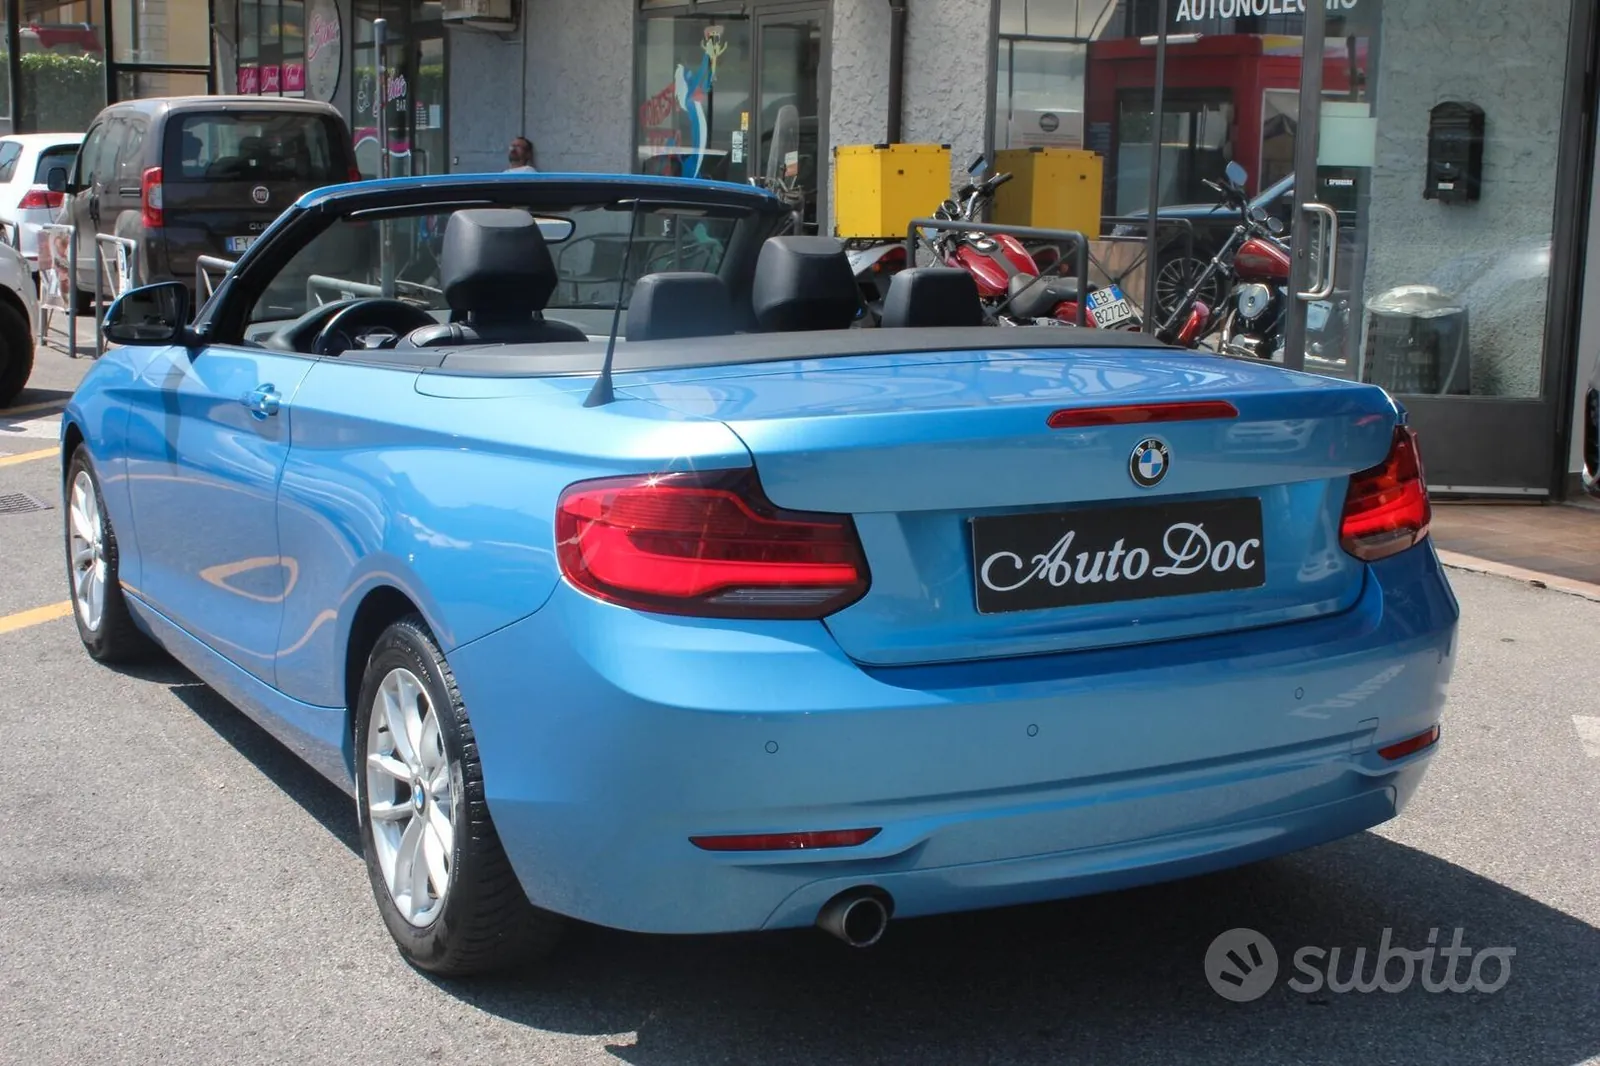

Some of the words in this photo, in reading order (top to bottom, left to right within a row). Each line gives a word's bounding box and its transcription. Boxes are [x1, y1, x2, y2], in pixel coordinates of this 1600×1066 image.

[1176, 0, 1357, 22] AUTONOLE
[1092, 290, 1109, 306] EB
[1094, 302, 1130, 324] 82720
[1136, 440, 1168, 456] BMW
